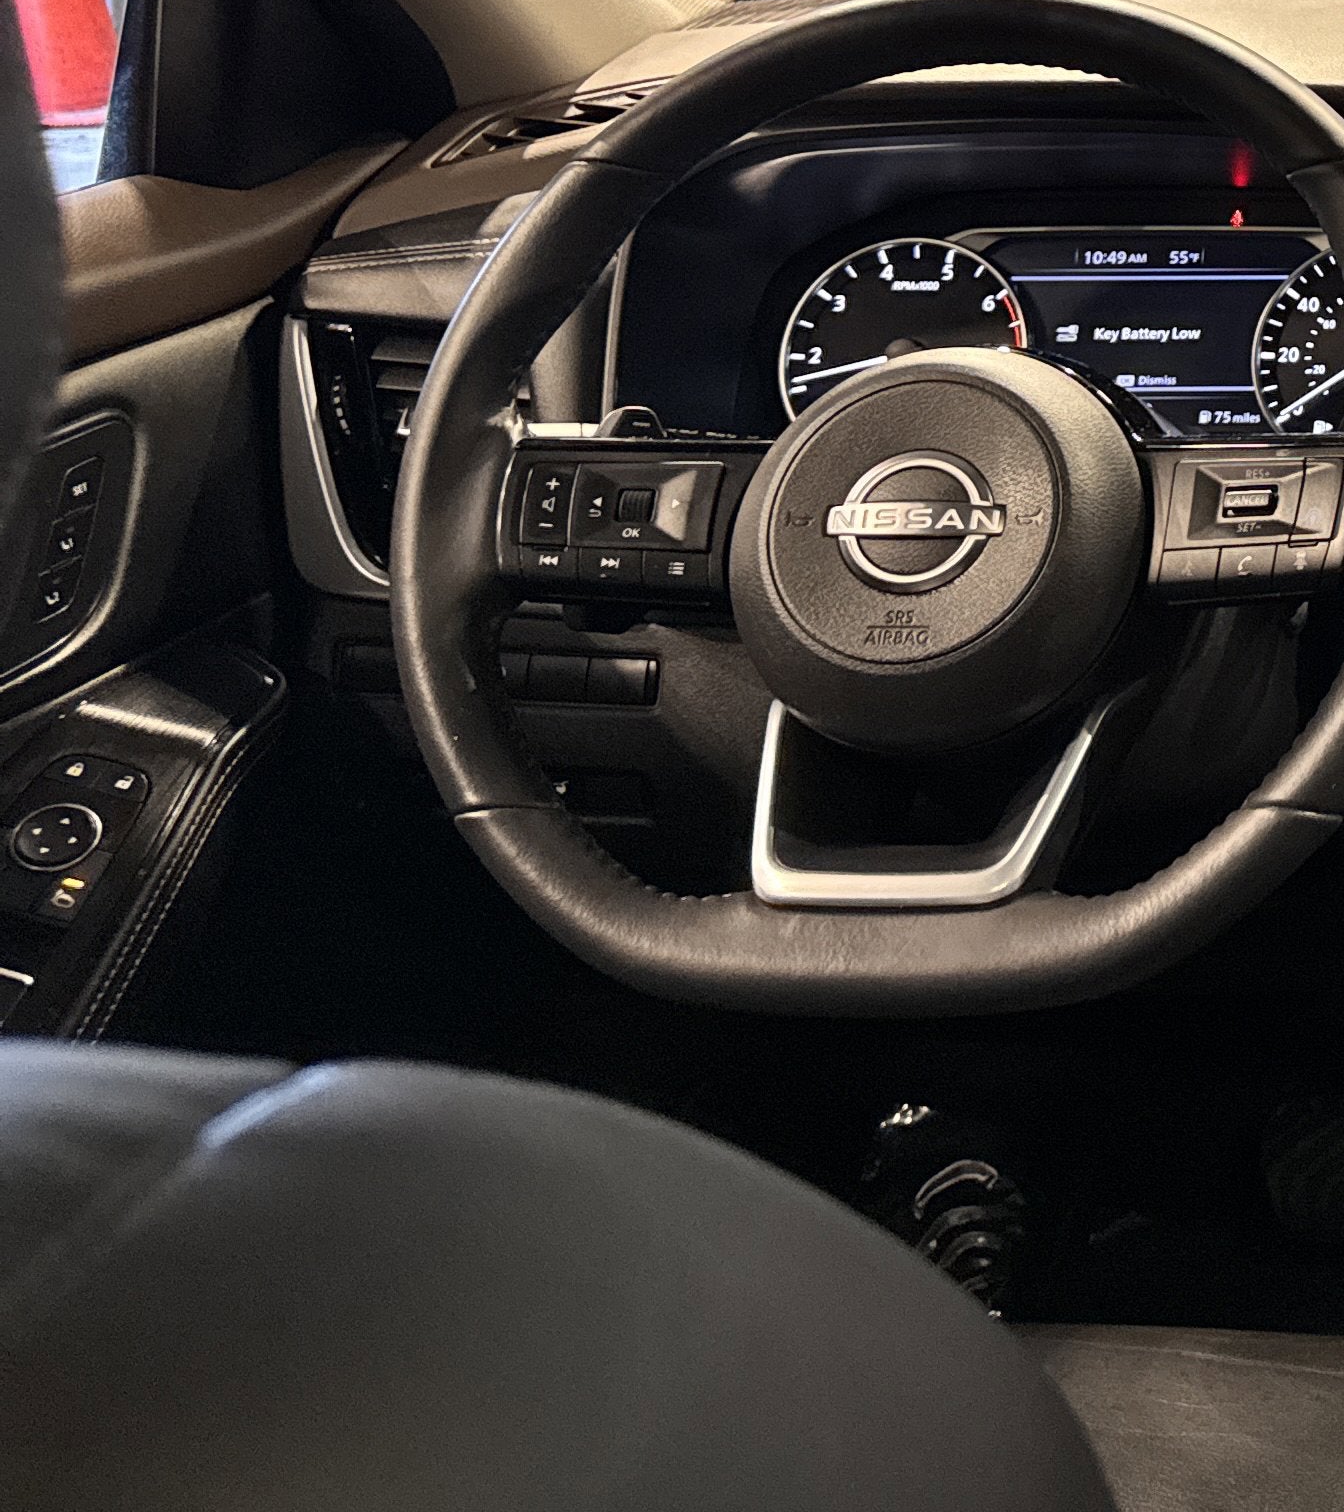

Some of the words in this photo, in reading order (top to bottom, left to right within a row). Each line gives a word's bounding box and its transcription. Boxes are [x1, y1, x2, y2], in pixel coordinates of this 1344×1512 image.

[879, 264, 894, 281] 4
[941, 264, 955, 281] 5
[831, 294, 846, 312] 3
[981, 294, 996, 312] 6
[1297, 296, 1320, 313] 40
[1093, 327, 1119, 343] Key
[1121, 327, 1170, 343] Battery
[1171, 327, 1201, 339] Low
[808, 347, 823, 365] 2
[1277, 347, 1300, 363] 20
[1311, 364, 1325, 375] 20
[1138, 374, 1176, 386] Dismiss
[1213, 411, 1231, 423] 75
[1232, 411, 1261, 423] miles
[831, 508, 1001, 530] NISSAN
[621, 528, 641, 538] OK
[885, 610, 915, 625] SRS
[863, 630, 929, 646] AIRBAG
